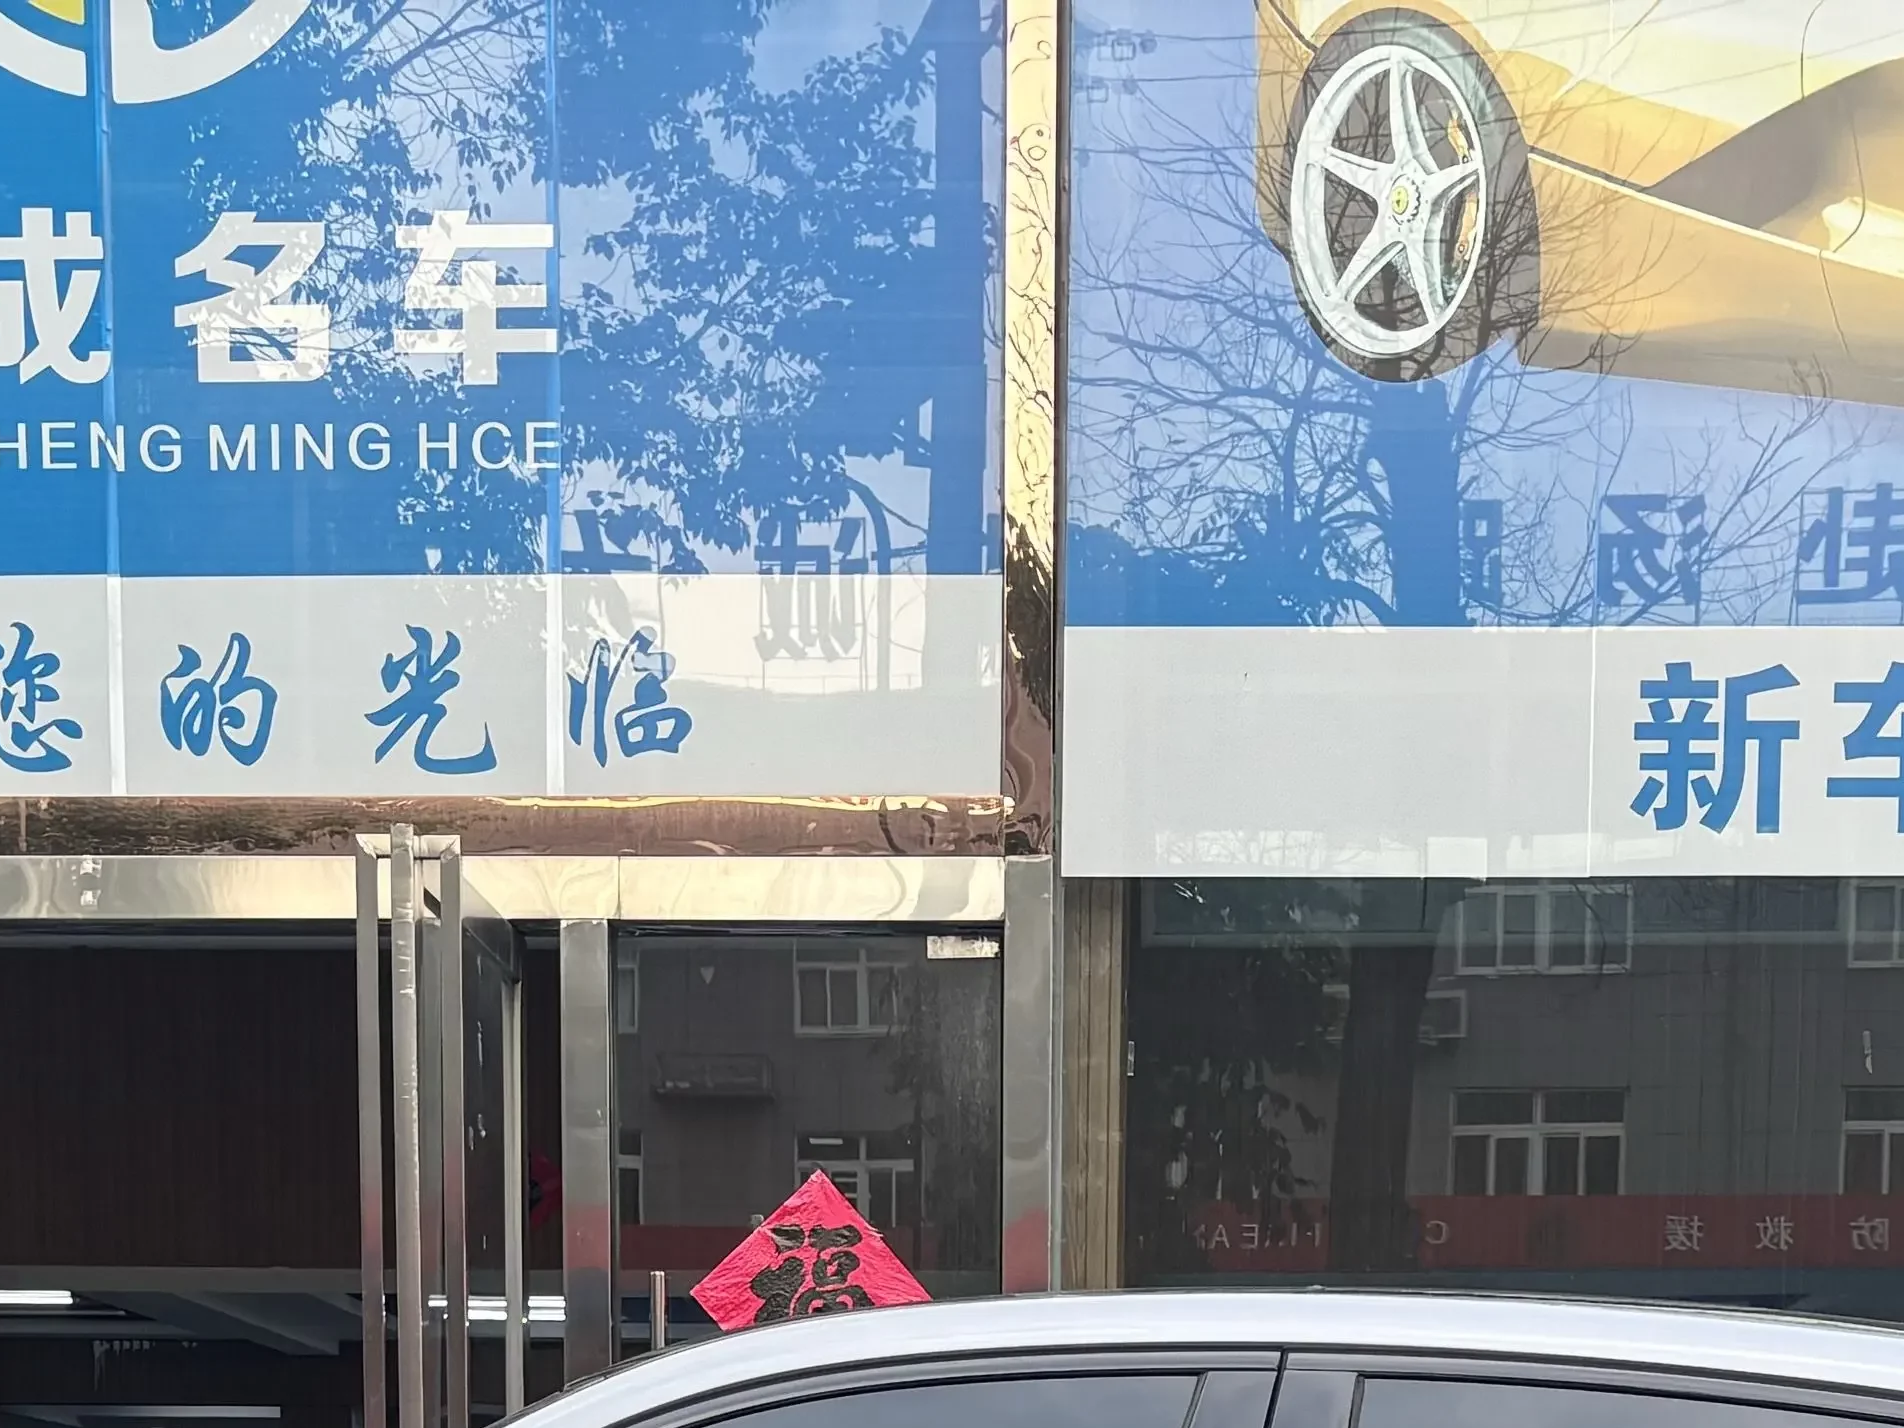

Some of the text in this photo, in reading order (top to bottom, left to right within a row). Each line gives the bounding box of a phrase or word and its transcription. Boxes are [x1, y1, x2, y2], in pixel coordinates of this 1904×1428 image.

[209, 421, 392, 472] MING
[418, 419, 560, 471] HCE
[750, 1223, 879, 1324] 福
